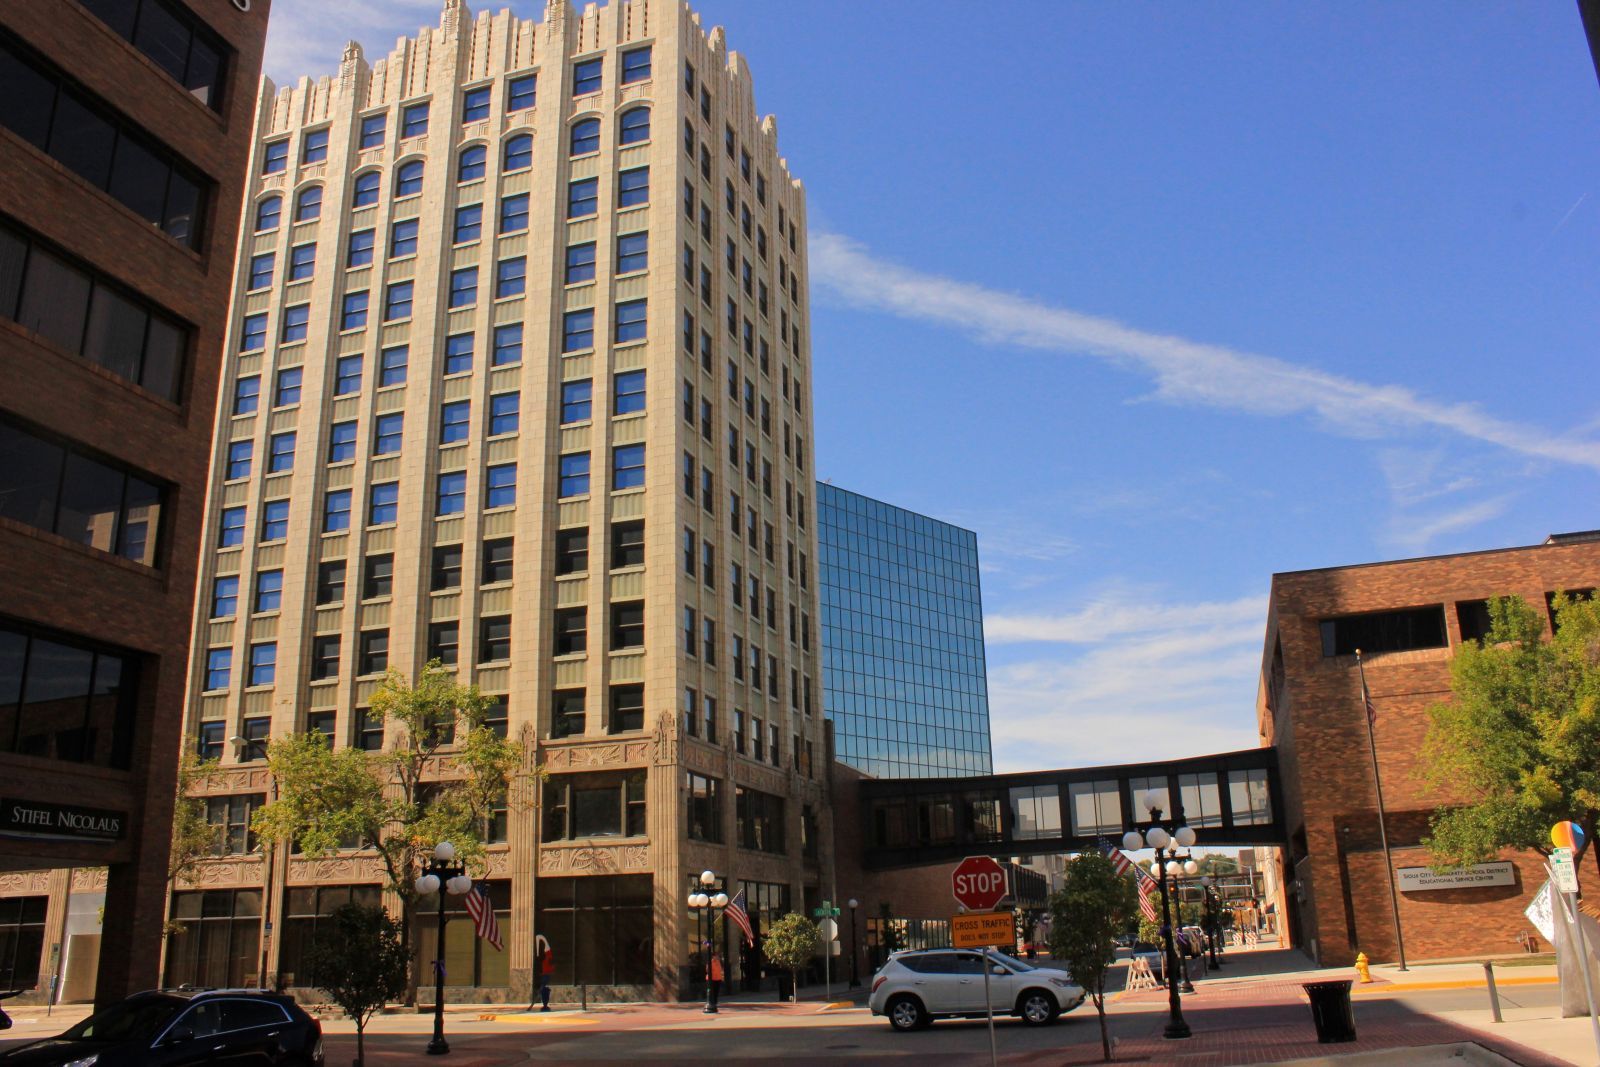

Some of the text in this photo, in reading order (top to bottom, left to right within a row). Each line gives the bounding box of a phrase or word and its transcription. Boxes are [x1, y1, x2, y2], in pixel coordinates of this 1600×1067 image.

[11, 806, 120, 832] STIFEL NICOLAUS
[956, 872, 1002, 895] STOP
[954, 918, 1010, 931] CROSS TRAFFIC
[960, 931, 1006, 942] DOES NOT STOP
